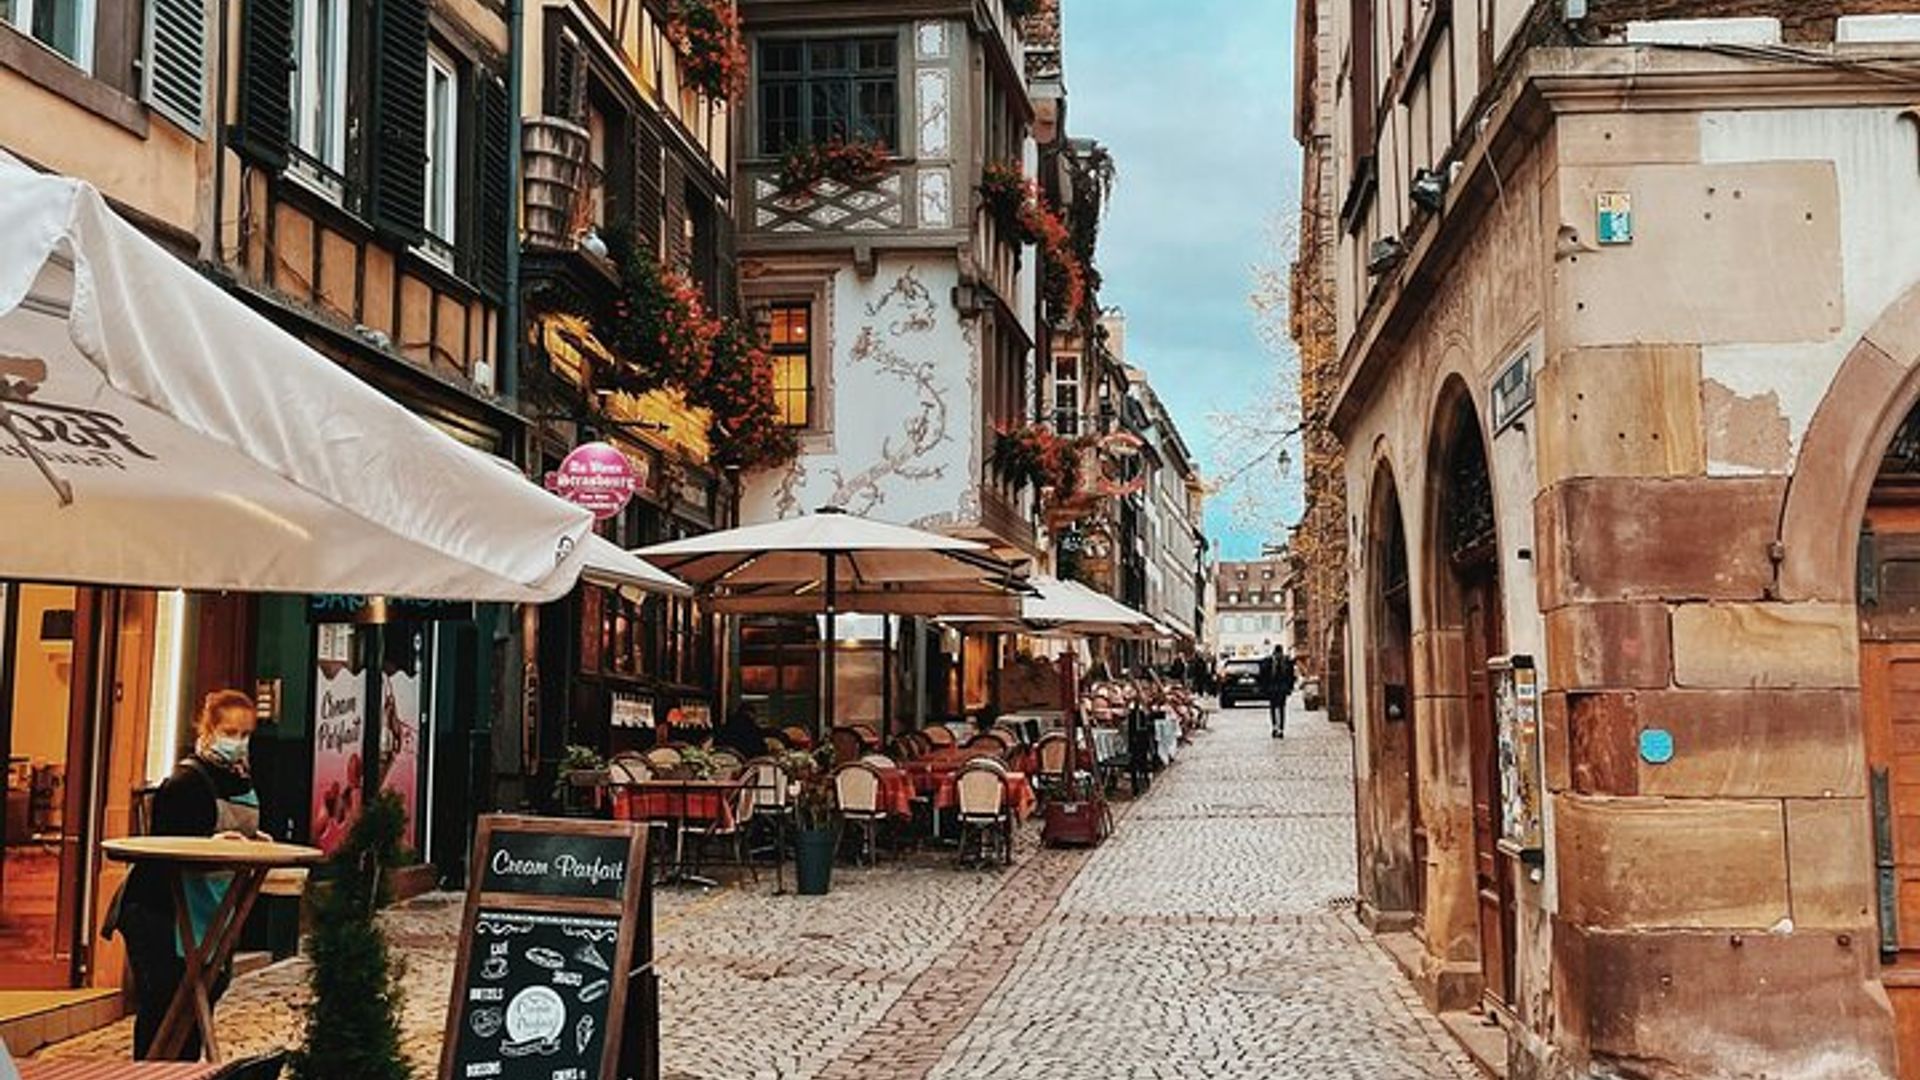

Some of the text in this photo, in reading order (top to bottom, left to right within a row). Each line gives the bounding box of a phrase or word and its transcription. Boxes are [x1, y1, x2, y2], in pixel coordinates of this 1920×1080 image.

[557, 473, 636, 491] Strasbourg
[321, 691, 357, 720] Cream
[317, 715, 362, 754] Parfait
[492, 849, 624, 885] Cream Parfait
